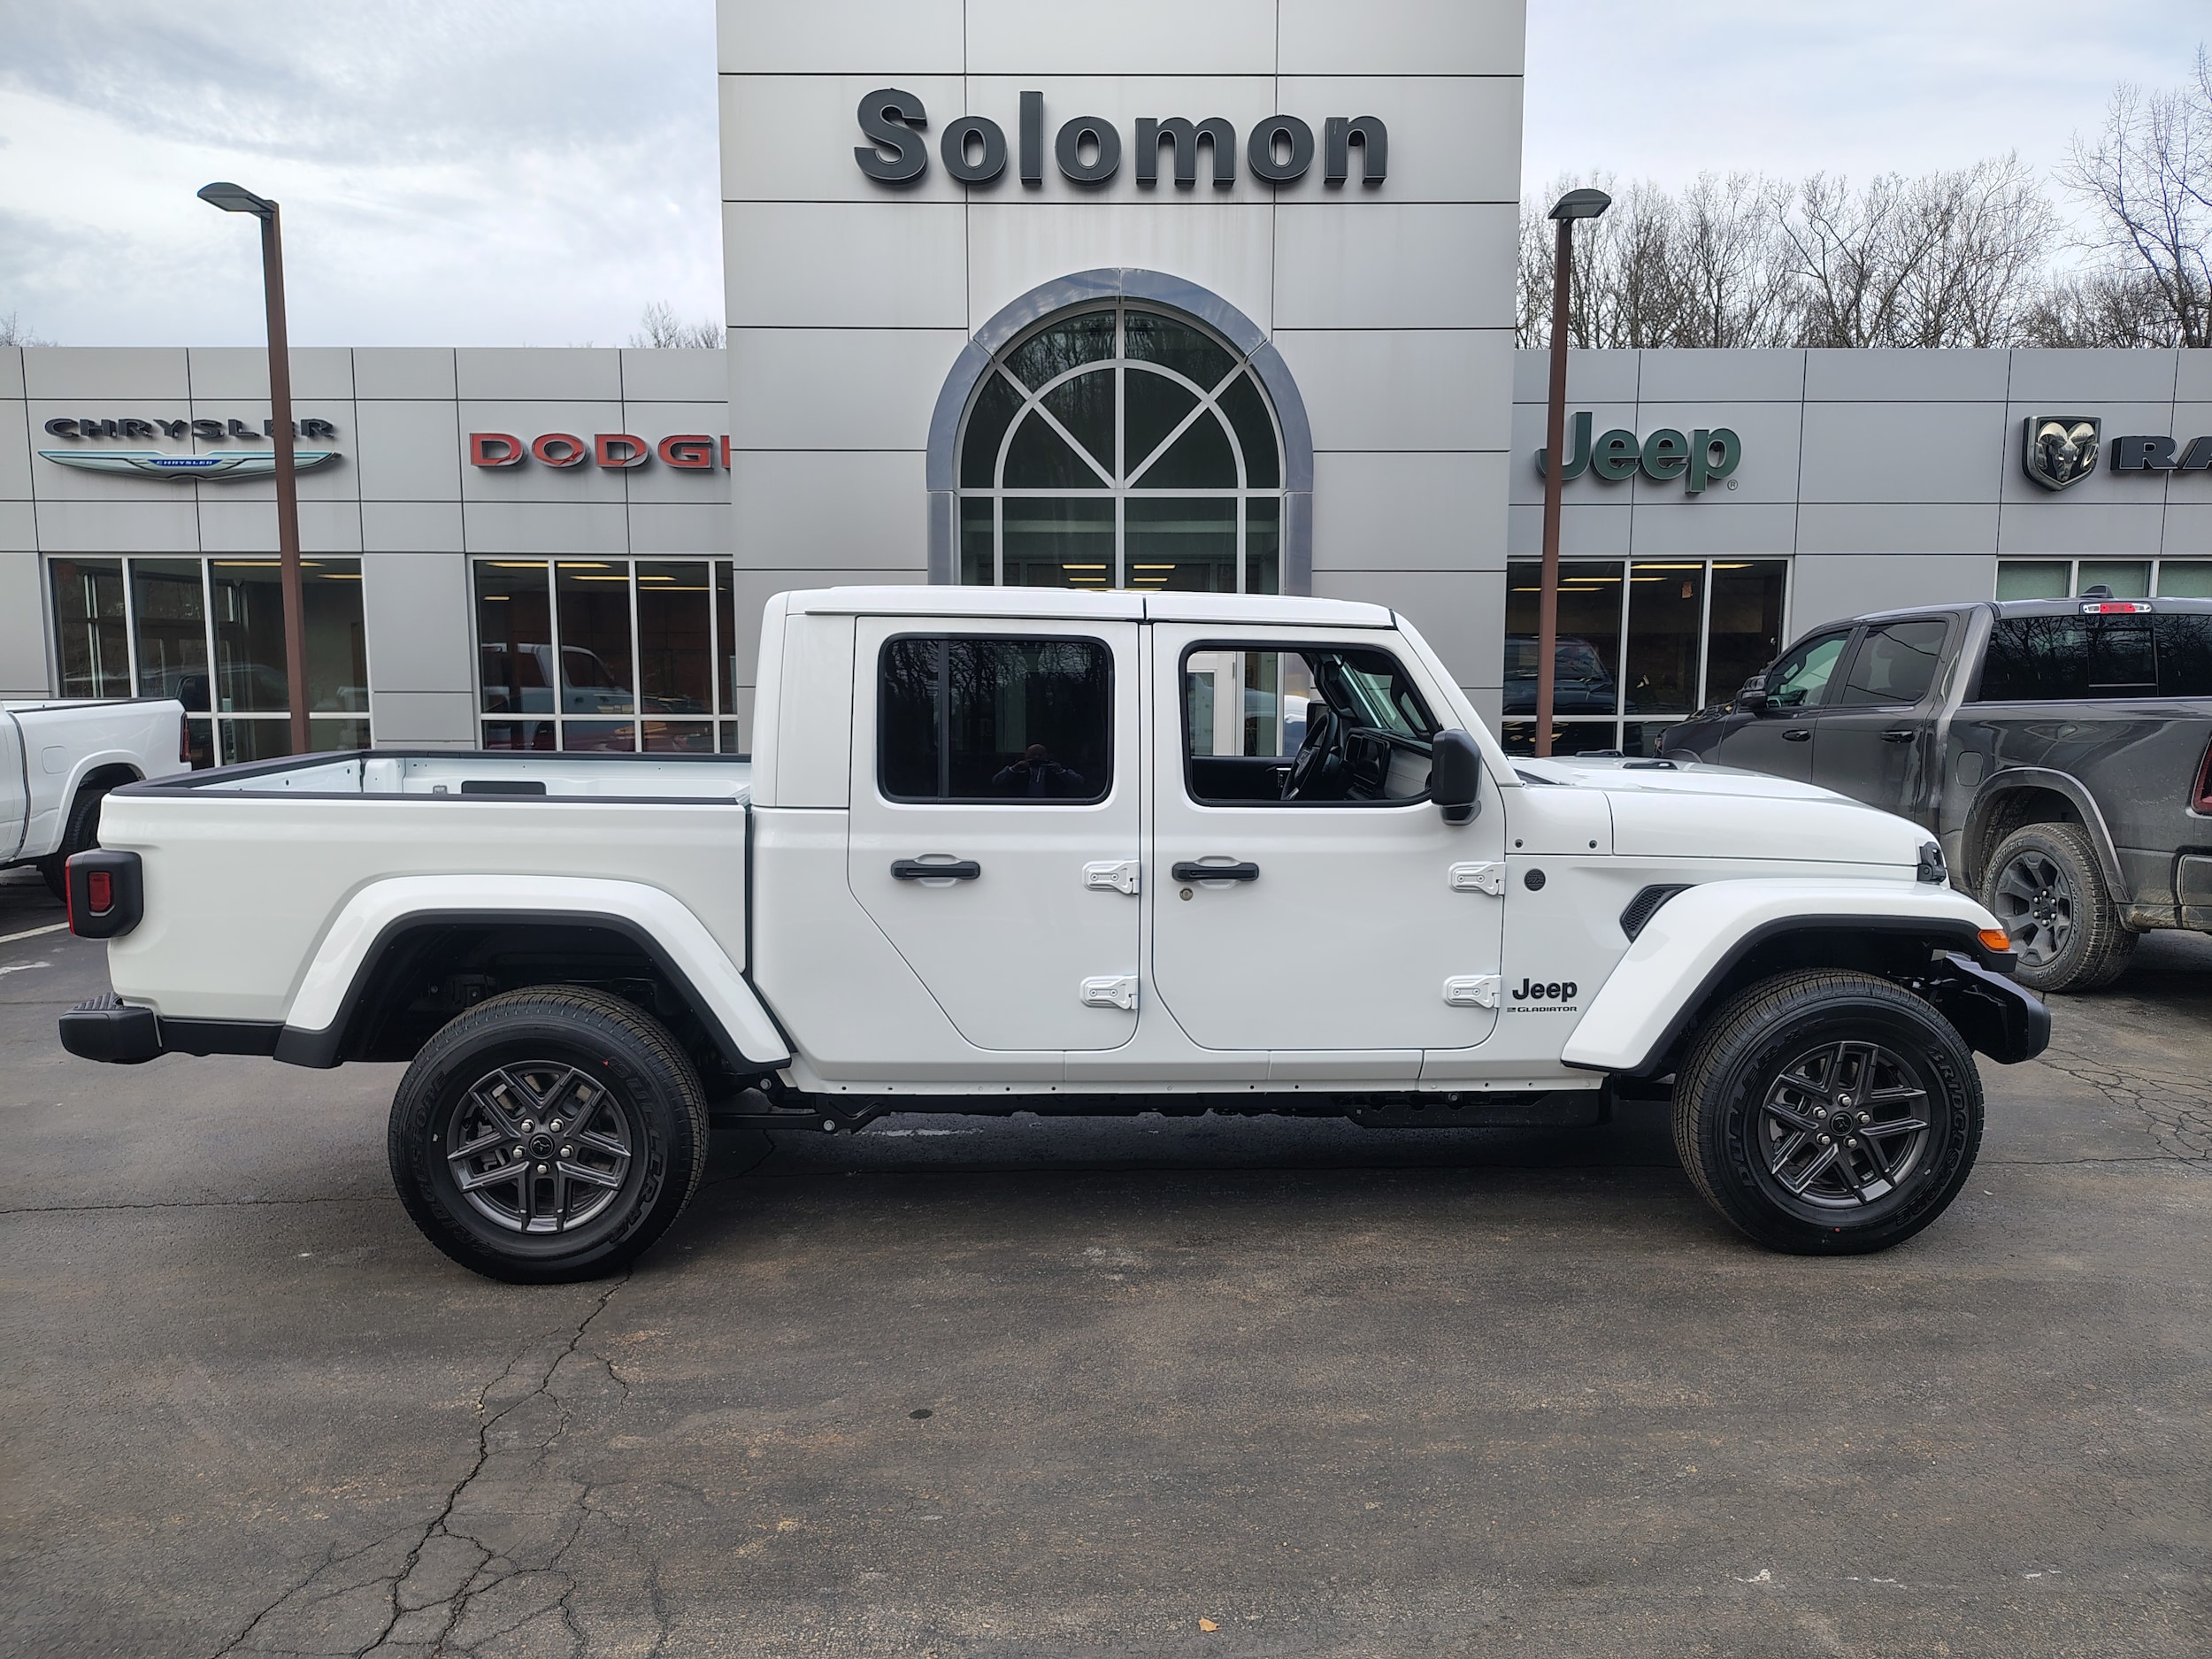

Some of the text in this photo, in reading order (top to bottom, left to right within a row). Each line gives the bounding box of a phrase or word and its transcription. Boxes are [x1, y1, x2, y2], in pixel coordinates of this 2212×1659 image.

[854, 88, 1388, 186] Solomon
[44, 418, 334, 439] CHRYSLR
[470, 433, 731, 470] DODG
[1535, 411, 1741, 494] Jeep
[1512, 978, 1578, 1002] Jeep
